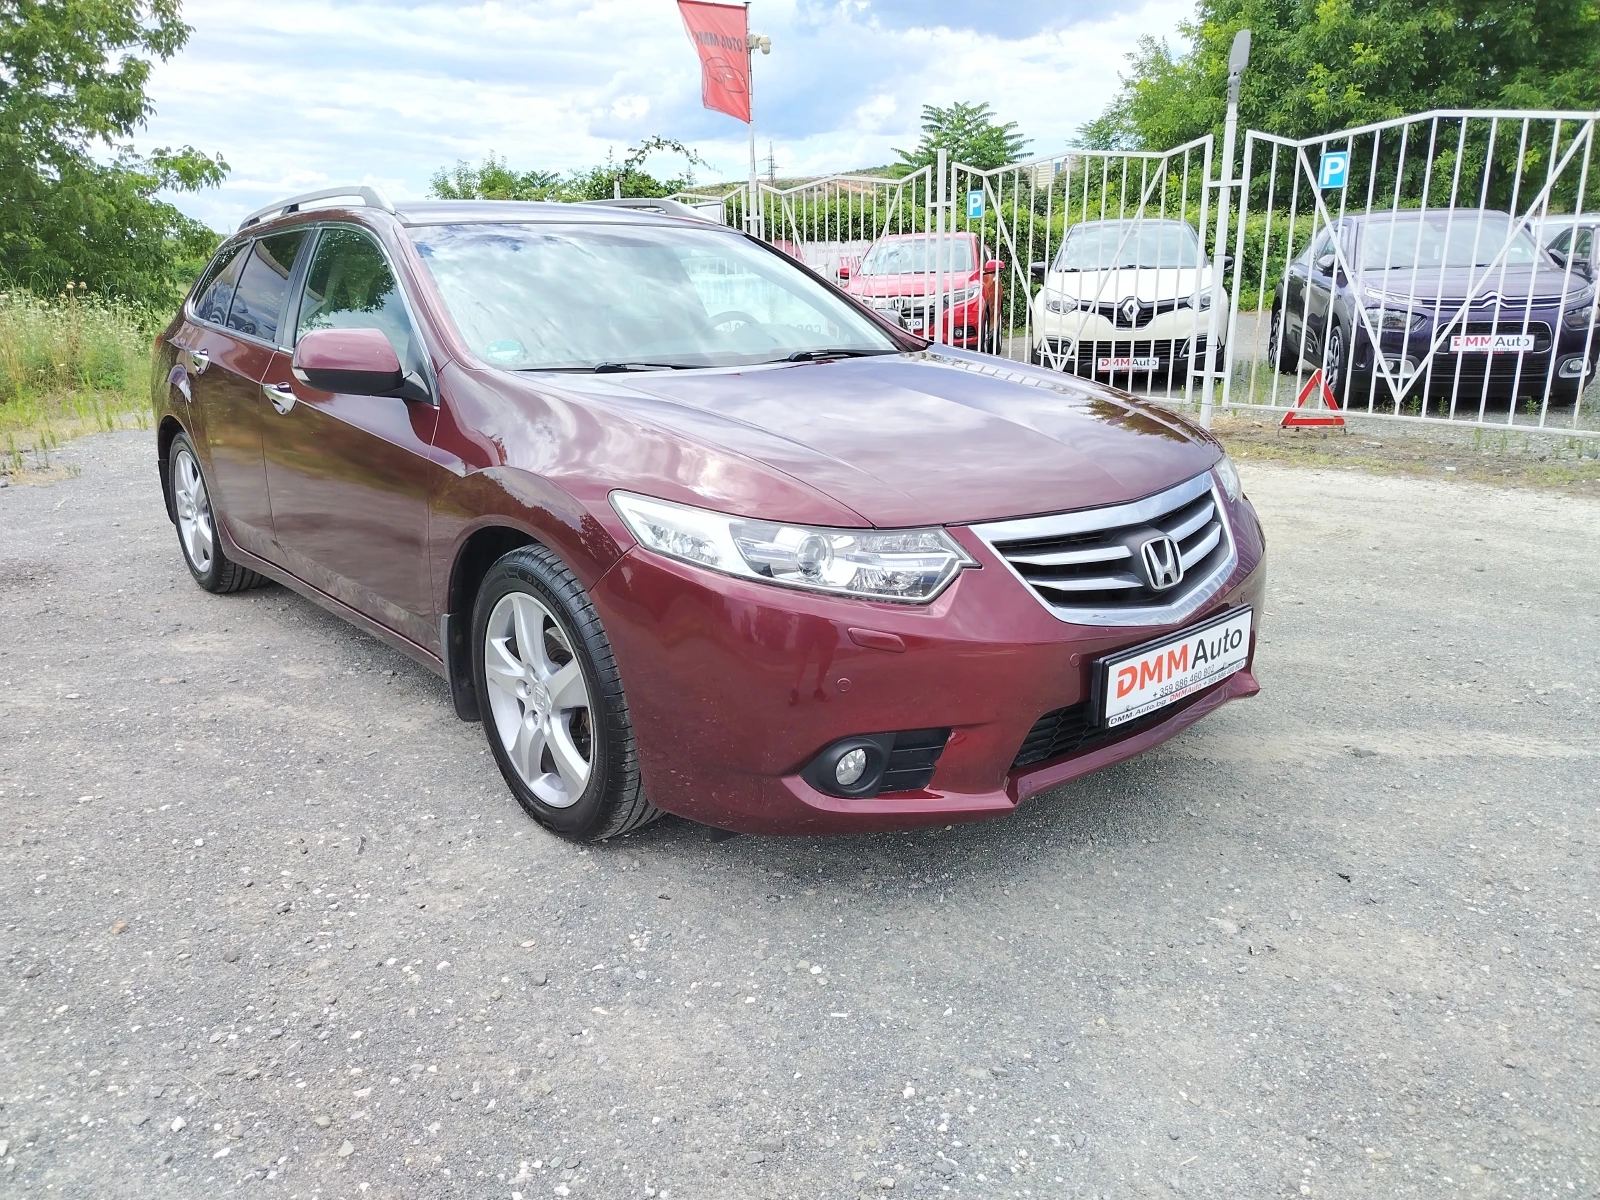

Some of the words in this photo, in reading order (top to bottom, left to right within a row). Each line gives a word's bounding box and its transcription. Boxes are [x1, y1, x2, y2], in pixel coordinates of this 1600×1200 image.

[721, 35, 742, 52] AUTO
[1322, 157, 1345, 185] P
[969, 194, 982, 216] P
[1116, 627, 1243, 699] DMMAuto
[1159, 683, 1174, 698] 359
[1174, 676, 1189, 691] 886
[1189, 670, 1202, 683] 460
[1110, 699, 1167, 725] DMM.Auto.bg
